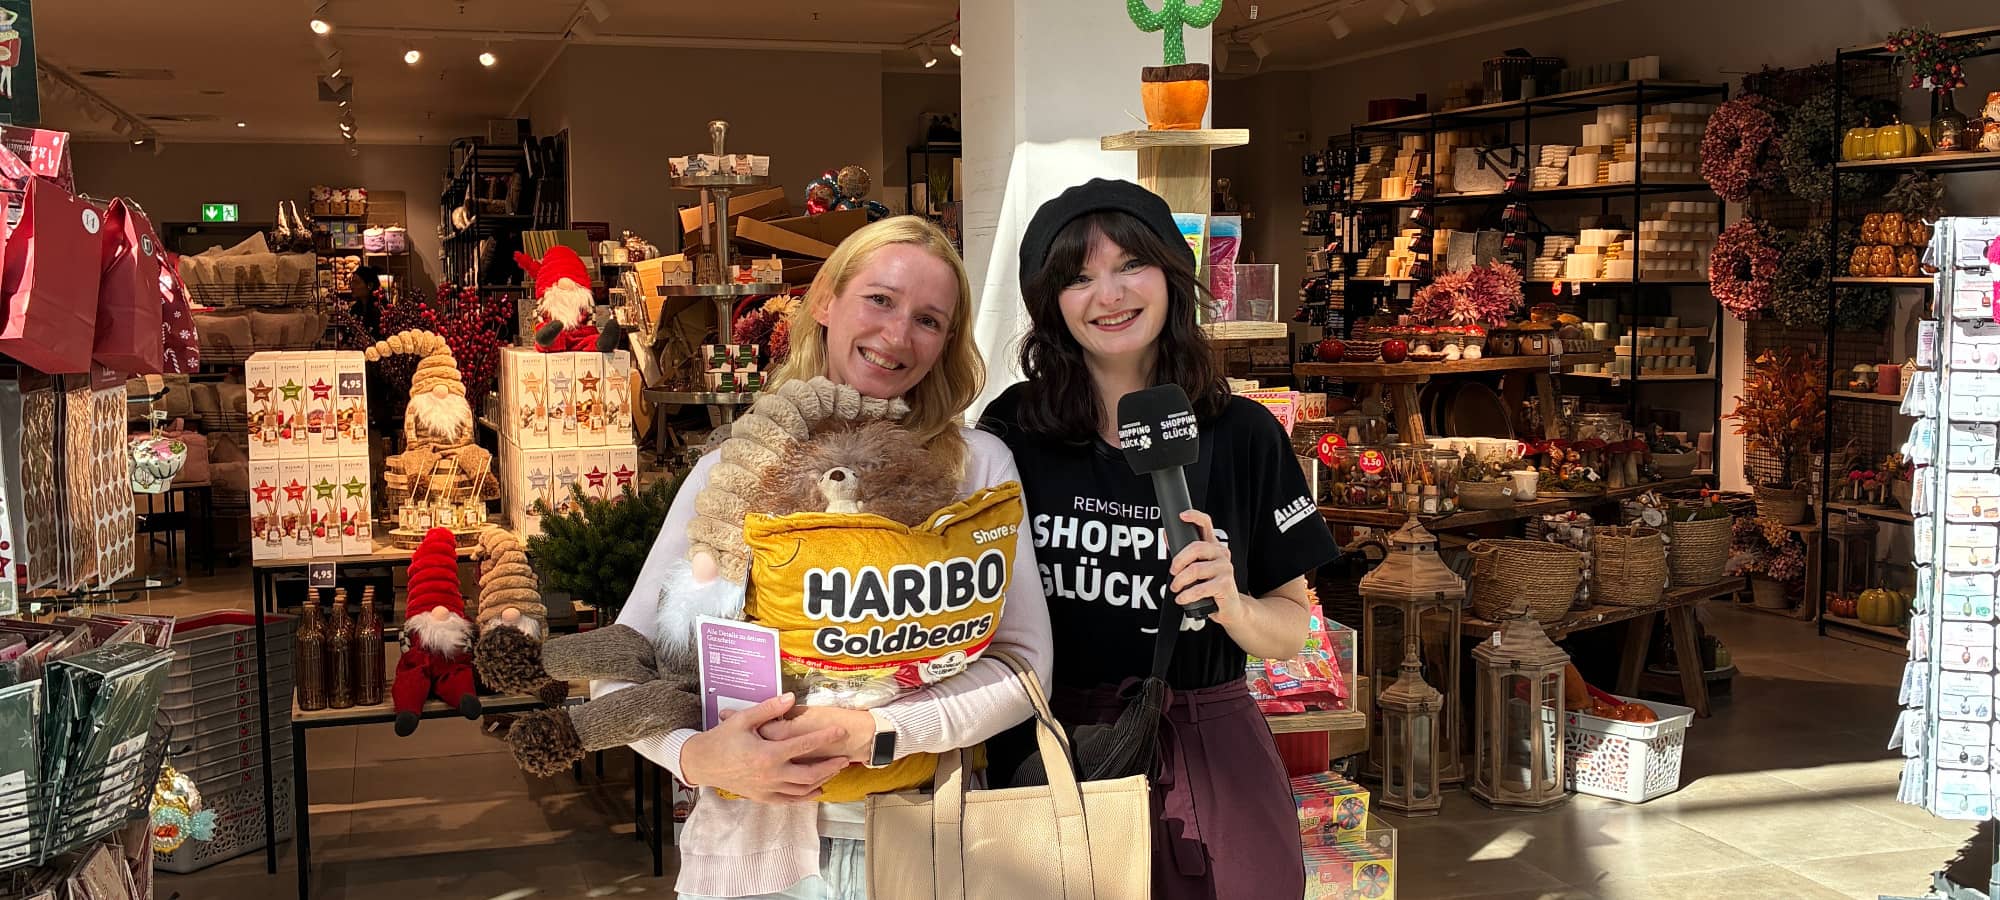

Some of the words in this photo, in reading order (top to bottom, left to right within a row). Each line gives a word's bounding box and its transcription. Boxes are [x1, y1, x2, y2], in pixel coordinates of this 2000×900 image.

[341, 380, 362, 389] 4,95
[1160, 414, 1197, 430] SHOPPING
[1162, 427, 1188, 440] GLÜCK
[1362, 457, 1381, 467] 3,50
[972, 525, 1009, 545] Share
[1034, 513, 1230, 561] SHOPPIG
[312, 570, 332, 580] 4,95
[806, 551, 1005, 620] HARIBO
[719, 630, 739, 639] Details
[815, 613, 992, 657] Goldbears
